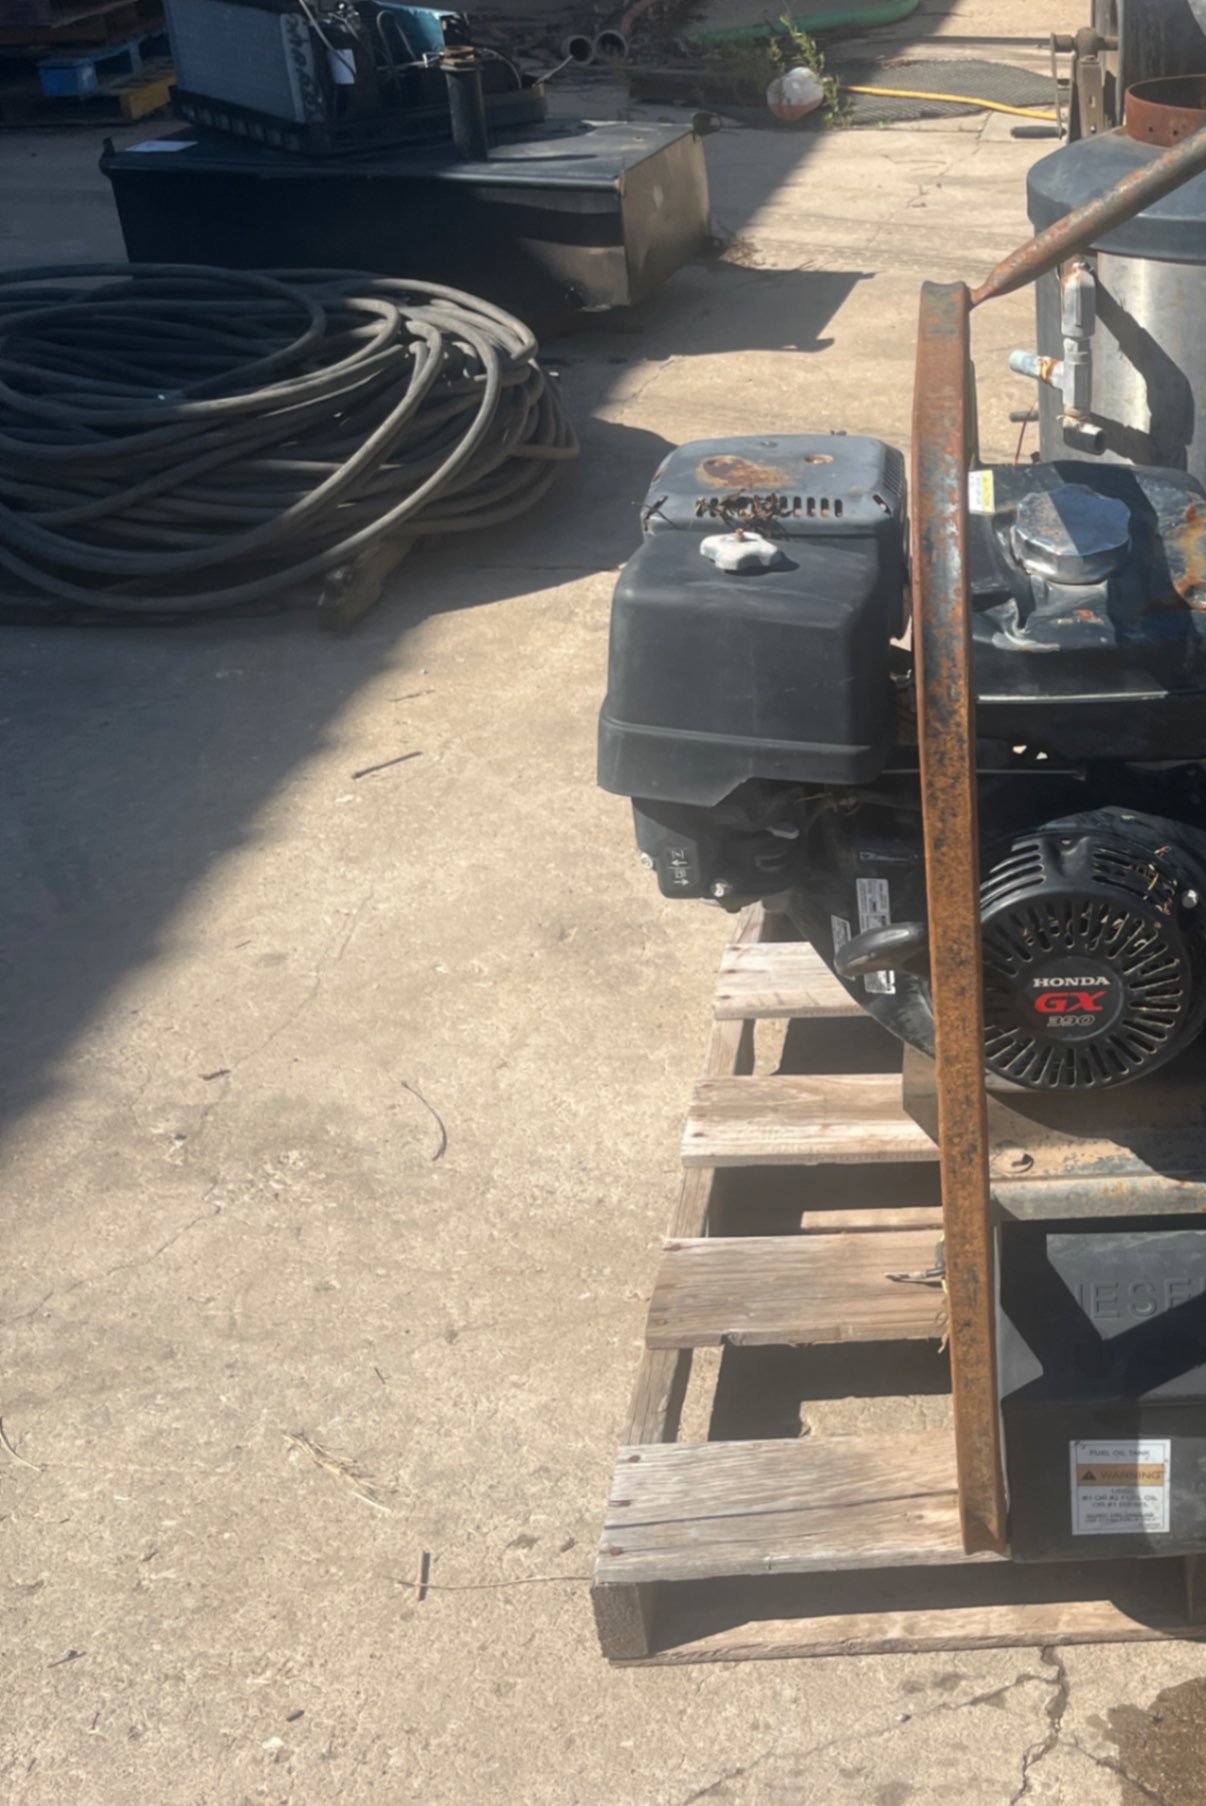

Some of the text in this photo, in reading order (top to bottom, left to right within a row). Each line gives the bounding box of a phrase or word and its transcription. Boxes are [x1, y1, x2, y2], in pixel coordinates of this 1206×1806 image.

[1033, 976, 1111, 987] HONDA
[1034, 991, 1107, 1014] GX
[1100, 1470, 1161, 1479] WARNING
